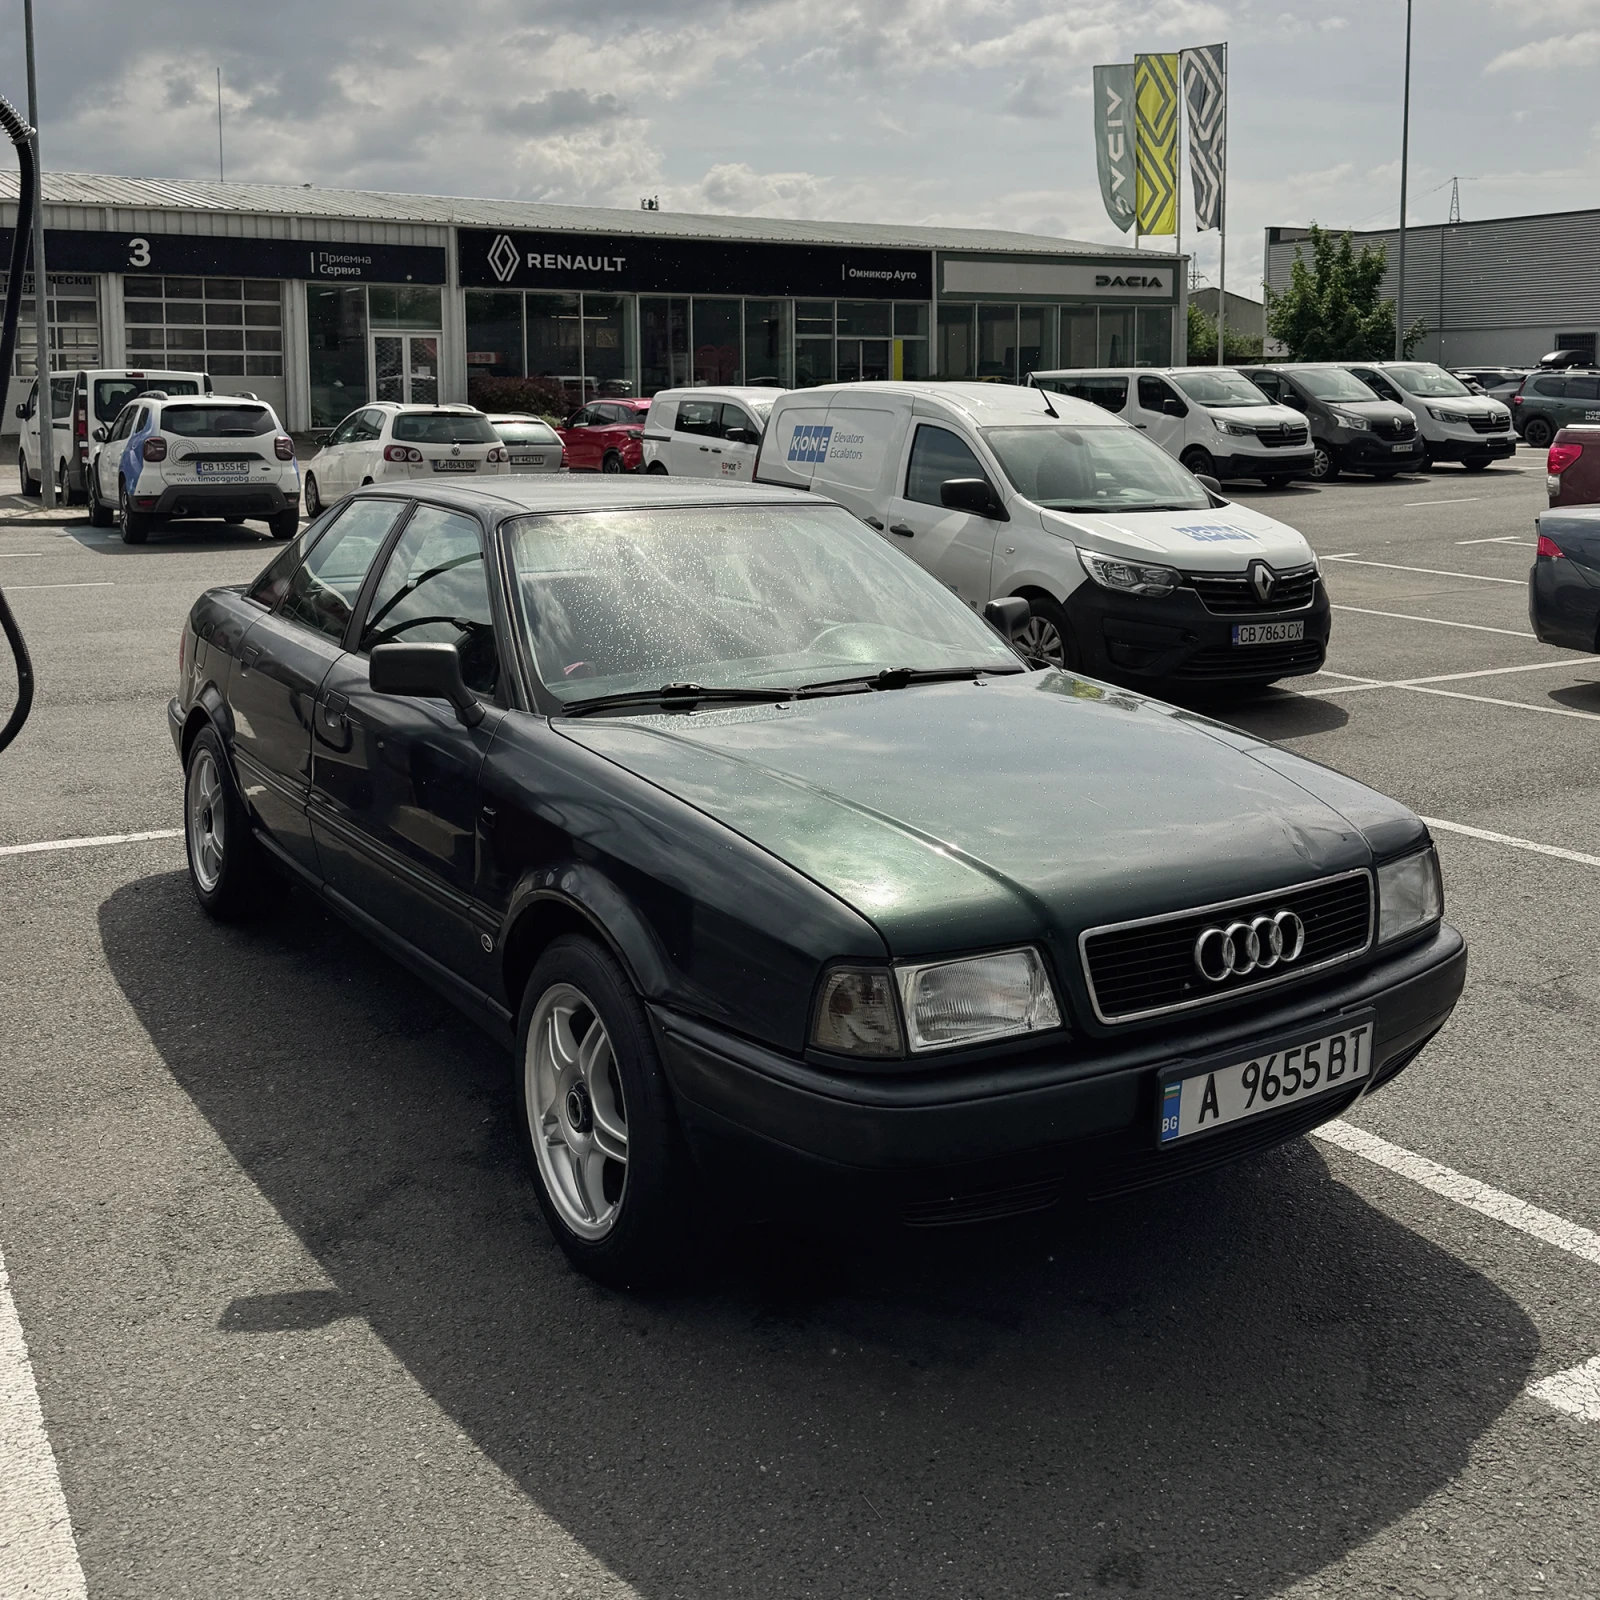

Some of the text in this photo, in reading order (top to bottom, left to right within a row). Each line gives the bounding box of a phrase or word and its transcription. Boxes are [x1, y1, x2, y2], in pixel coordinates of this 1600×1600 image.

[129, 238, 151, 267] 3
[319, 252, 372, 265] Приемна
[527, 253, 626, 272] RENAULT
[320, 264, 361, 276] Сервиз
[849, 268, 917, 281] Омникар Ауто
[1095, 275, 1163, 287] DACIA
[791, 435, 829, 452] KONE
[834, 432, 864, 443] Elevators
[830, 447, 863, 459] Escalators
[202, 463, 247, 471] CB 1355 HE
[1241, 627, 1256, 642] CB
[1258, 625, 1286, 642] 7863
[1288, 623, 1302, 639] CX
[1161, 1026, 1368, 1133] BG A 9655 BT
